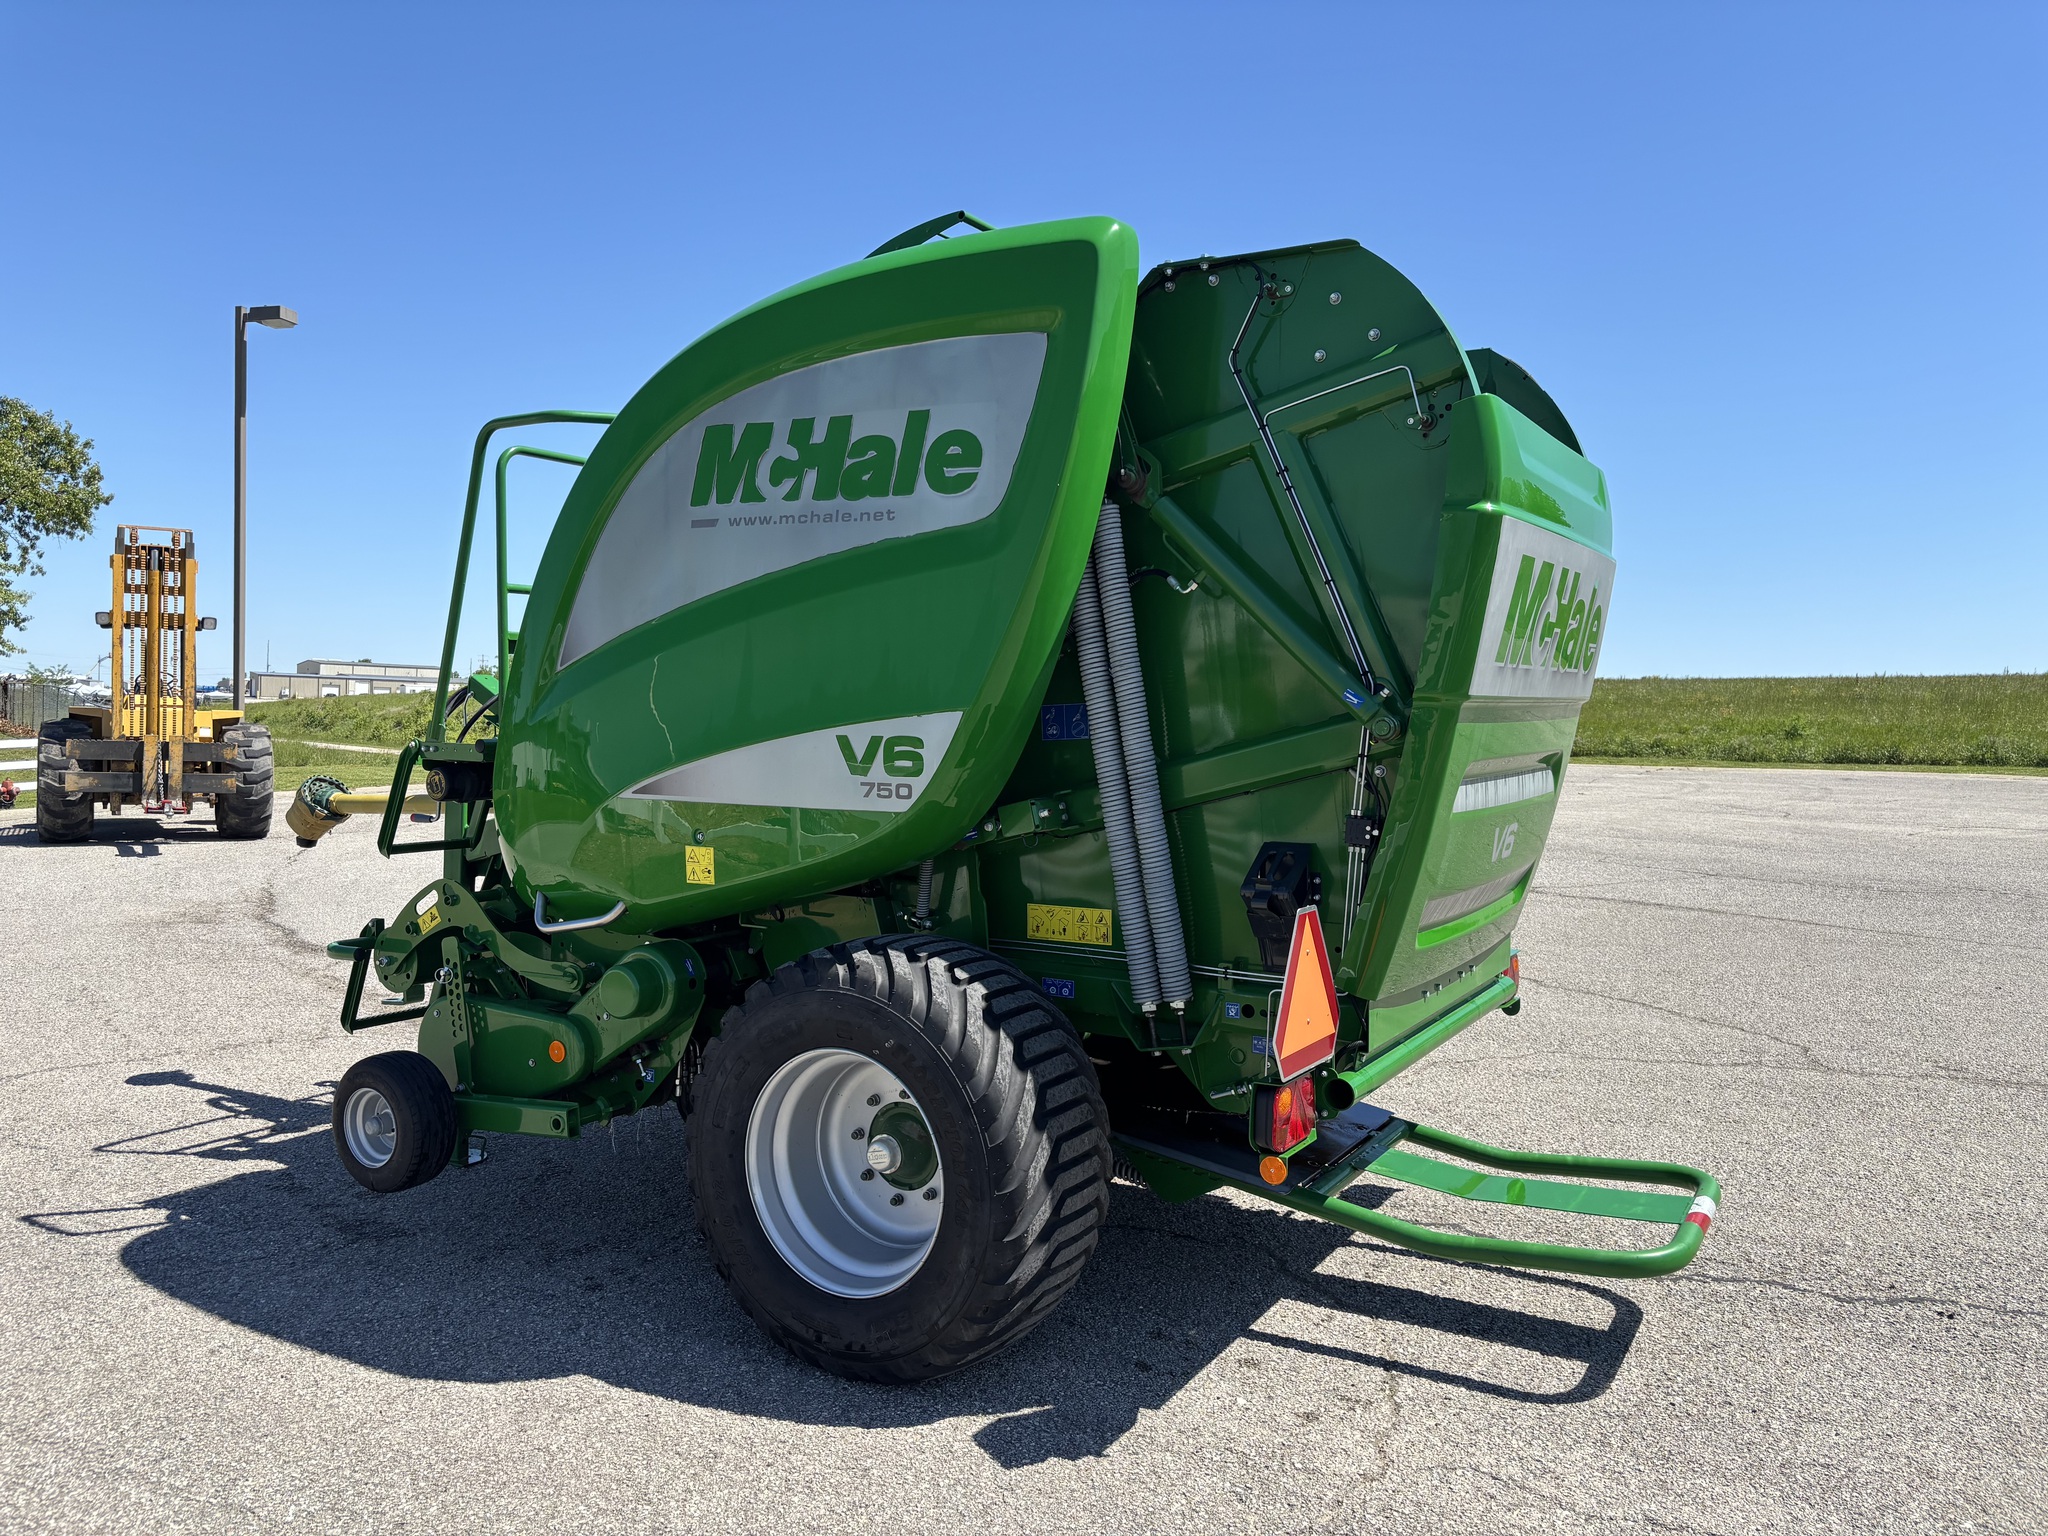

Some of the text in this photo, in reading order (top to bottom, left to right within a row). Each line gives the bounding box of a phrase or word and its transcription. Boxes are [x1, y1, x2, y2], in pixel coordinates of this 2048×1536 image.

[689, 409, 983, 507] McHale
[728, 509, 896, 528] www.mchale.net
[1494, 553, 1602, 674] McHale
[835, 734, 925, 778] V6
[859, 781, 913, 800] 750
[1491, 822, 1519, 863] V6
